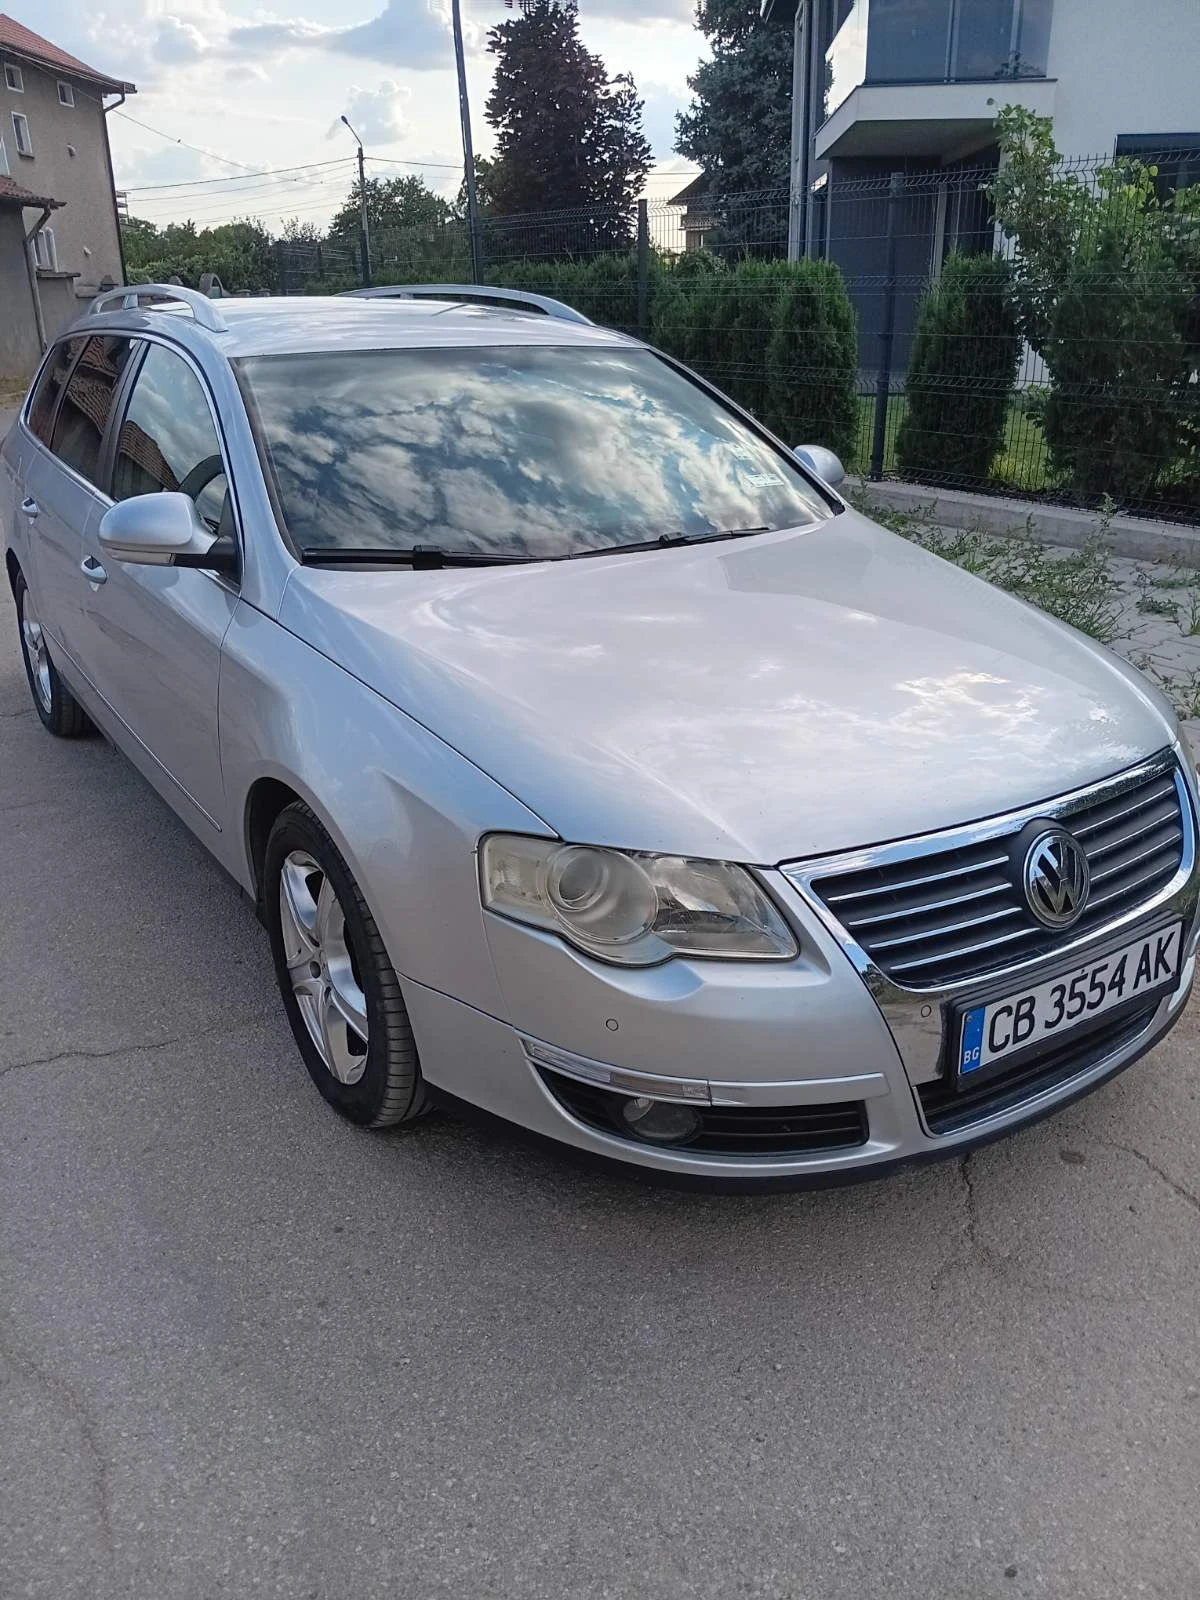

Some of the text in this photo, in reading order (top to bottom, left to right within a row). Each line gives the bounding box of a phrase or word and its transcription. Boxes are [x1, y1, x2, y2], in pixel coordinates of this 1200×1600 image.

[988, 931, 1175, 1054] CB 3554 AK
[963, 1049, 980, 1065] BG
